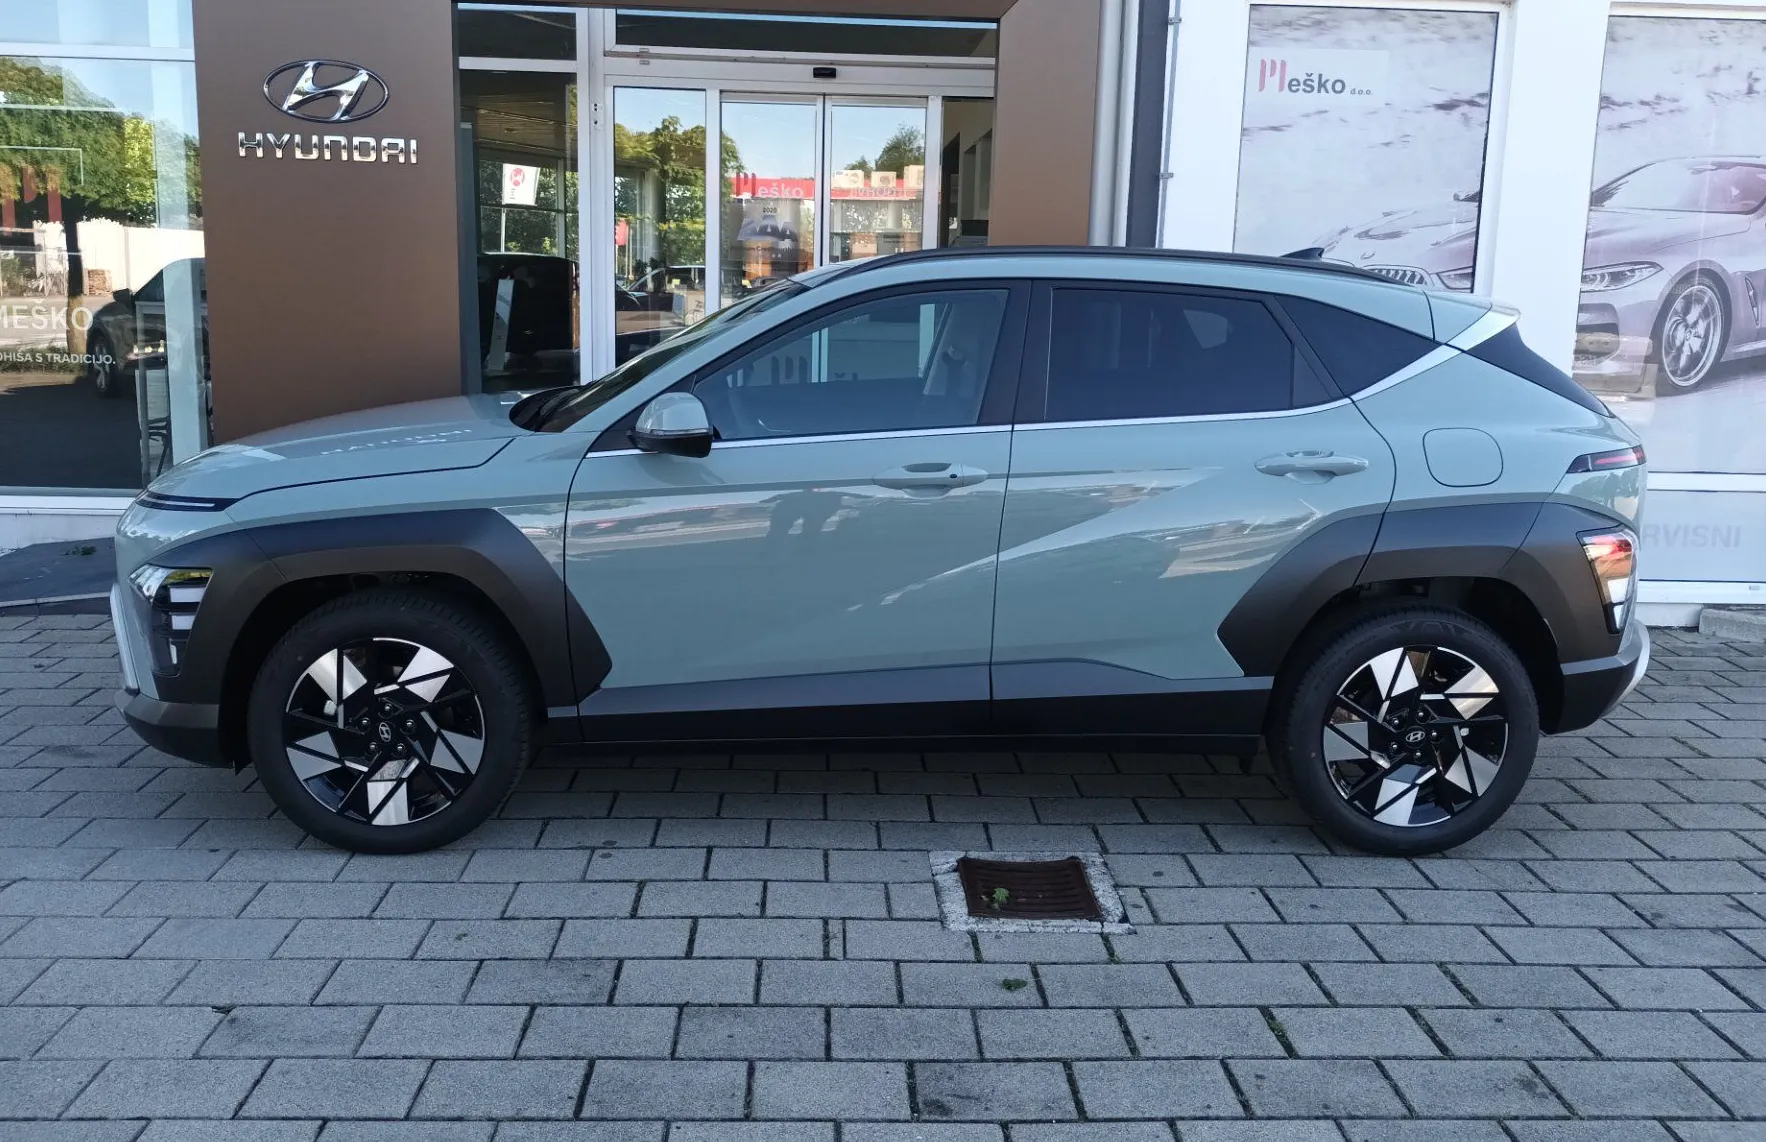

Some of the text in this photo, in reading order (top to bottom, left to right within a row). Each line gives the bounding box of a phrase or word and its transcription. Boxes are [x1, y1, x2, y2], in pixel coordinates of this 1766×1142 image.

[1258, 58, 1346, 95] Meško
[237, 131, 419, 165] HYUNDAI
[35, 353, 43, 363] S
[45, 353, 116, 365] TRADICIJO.
